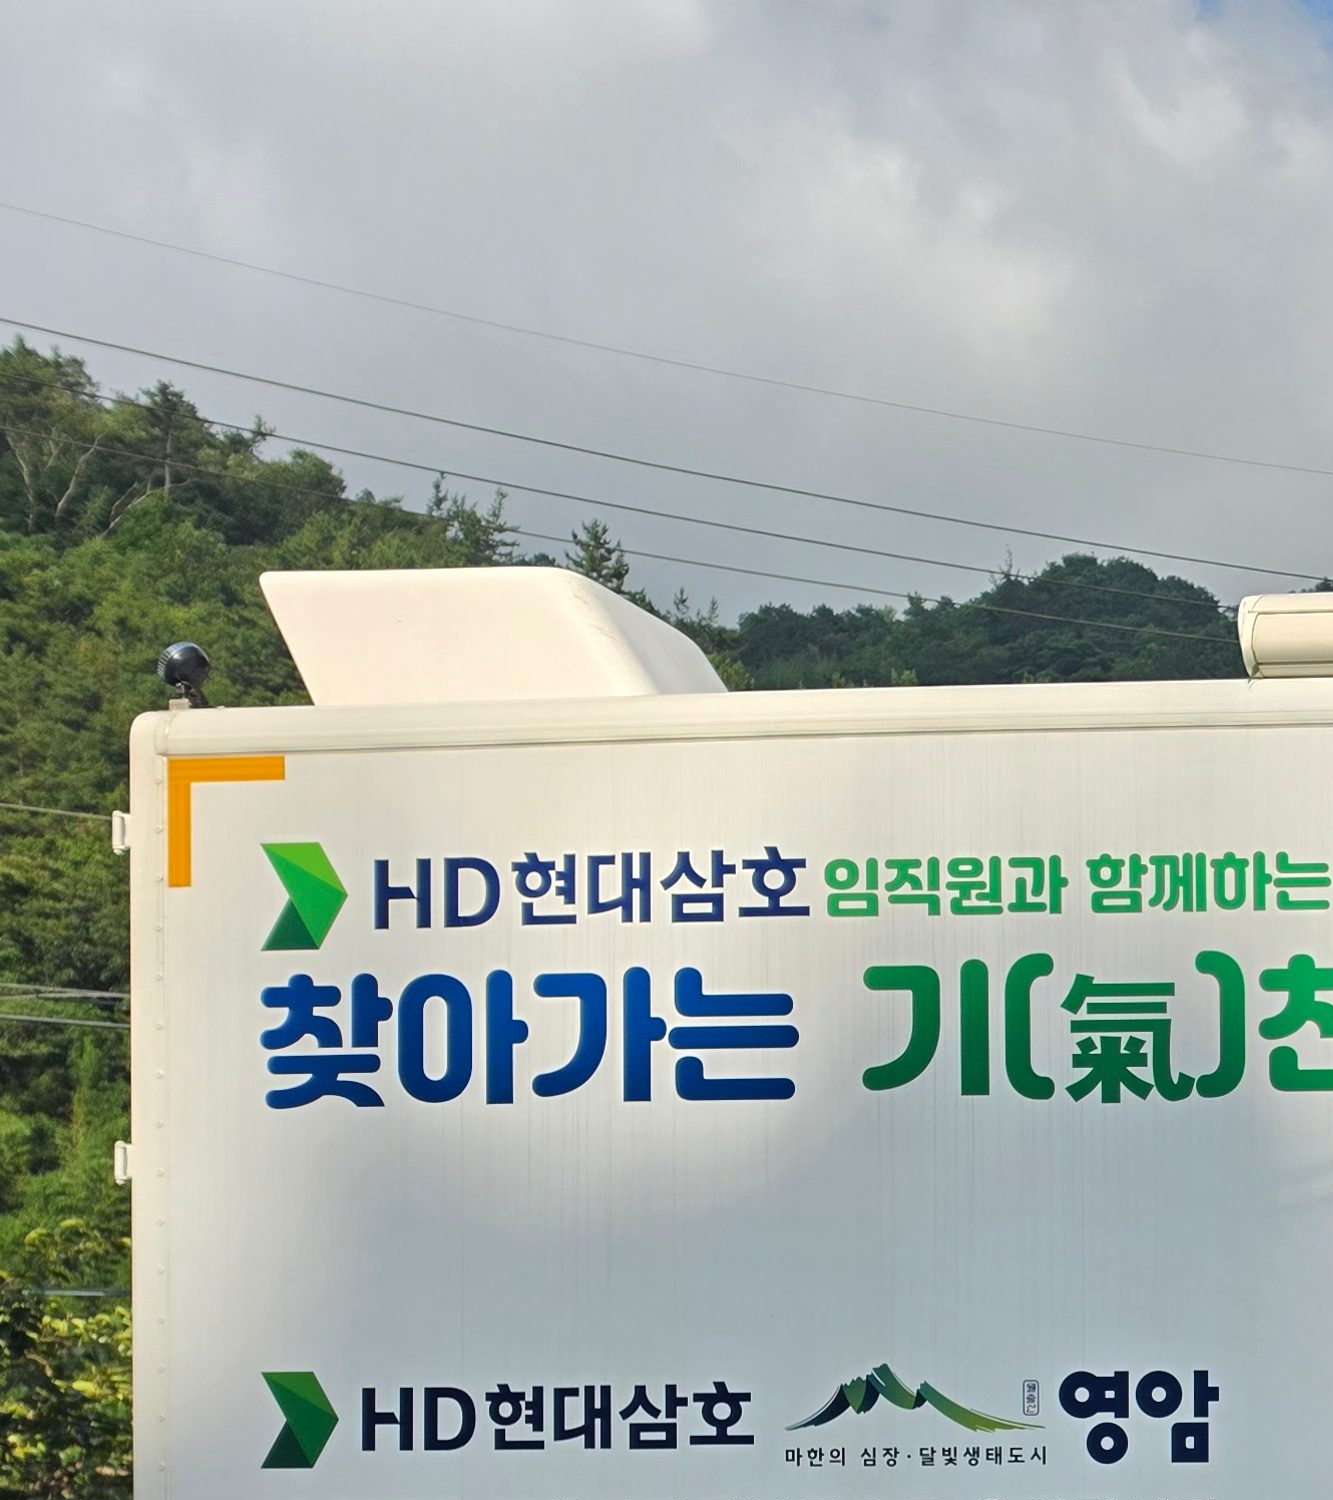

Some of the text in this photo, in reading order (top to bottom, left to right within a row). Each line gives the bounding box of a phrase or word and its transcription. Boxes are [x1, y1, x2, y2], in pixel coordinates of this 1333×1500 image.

[824, 855, 1069, 917] 임직원과
[1086, 851, 1332, 914] 함께하는
[260, 967, 800, 1110] 찾아가는
[785, 1447, 846, 1468] 마한의
[1058, 1369, 1220, 1465] 영암
